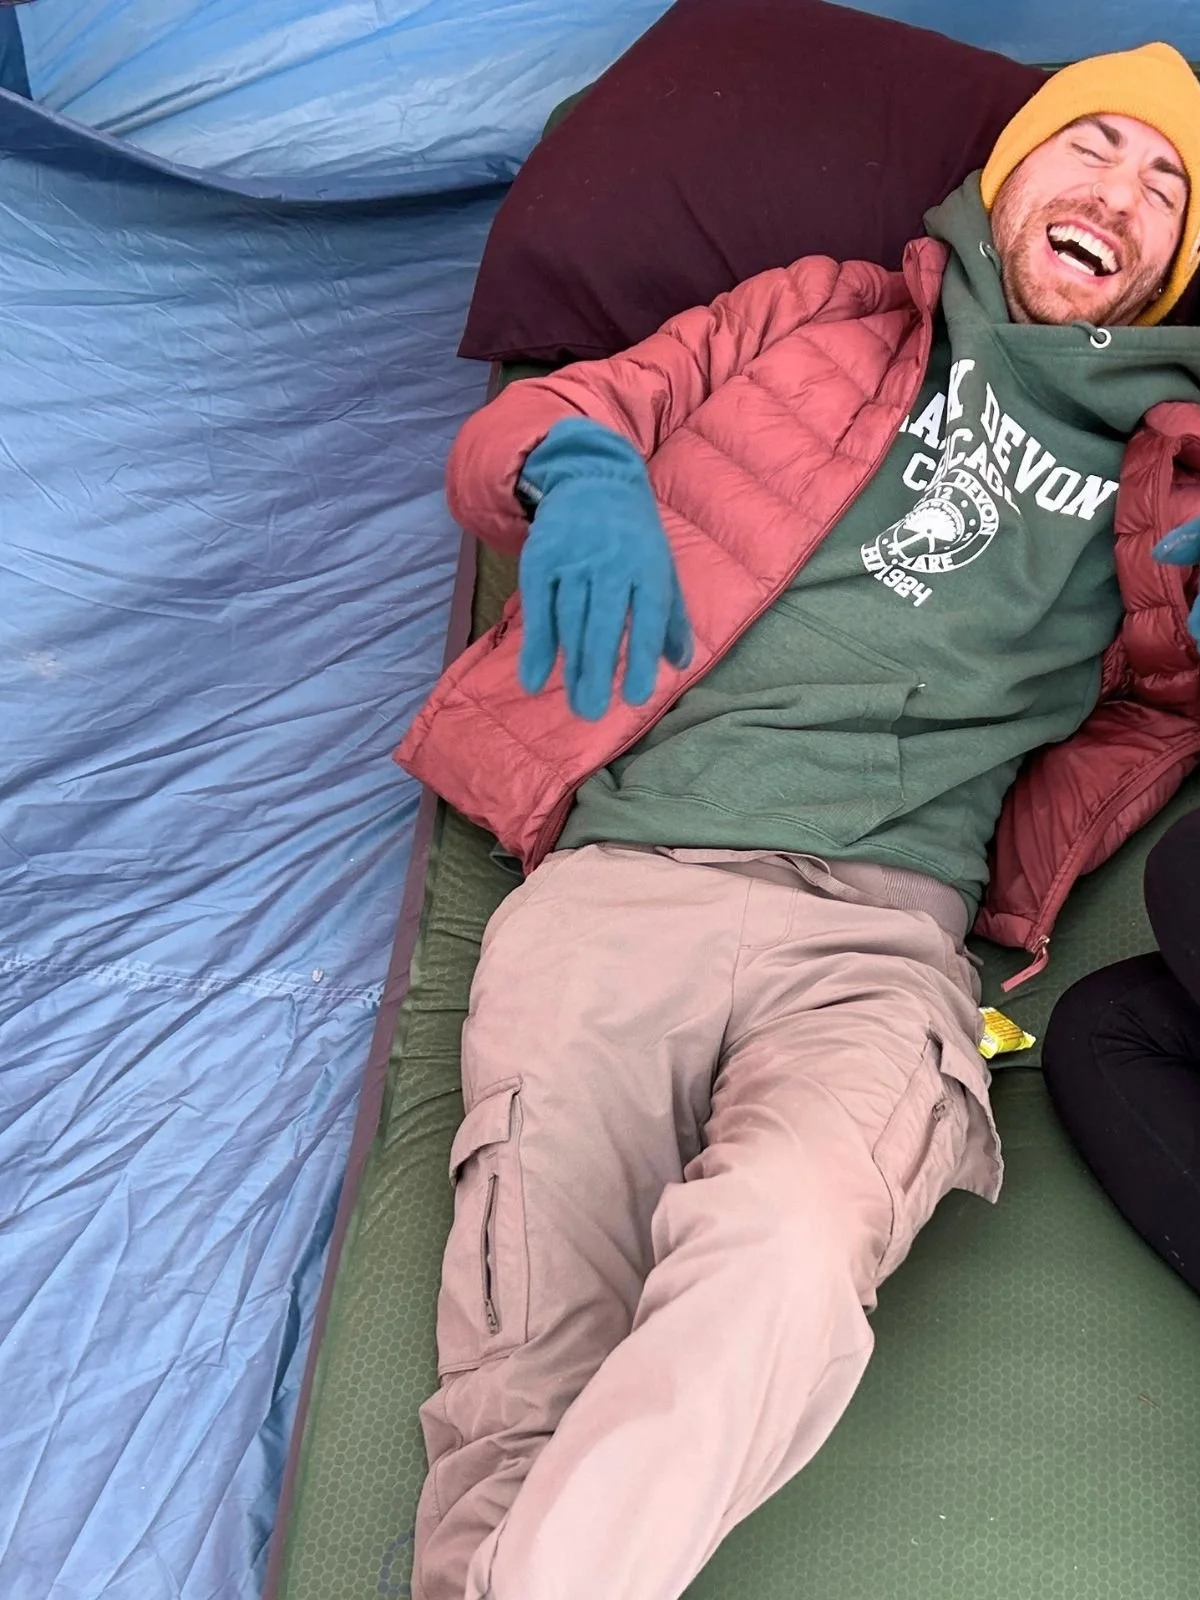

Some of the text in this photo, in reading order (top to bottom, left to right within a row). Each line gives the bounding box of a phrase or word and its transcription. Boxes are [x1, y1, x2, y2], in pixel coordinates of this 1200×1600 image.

[980, 382, 1119, 520] DEVON
[934, 486, 954, 501] 12
[953, 470, 998, 536] DEVON
[873, 564, 933, 607] 1924
